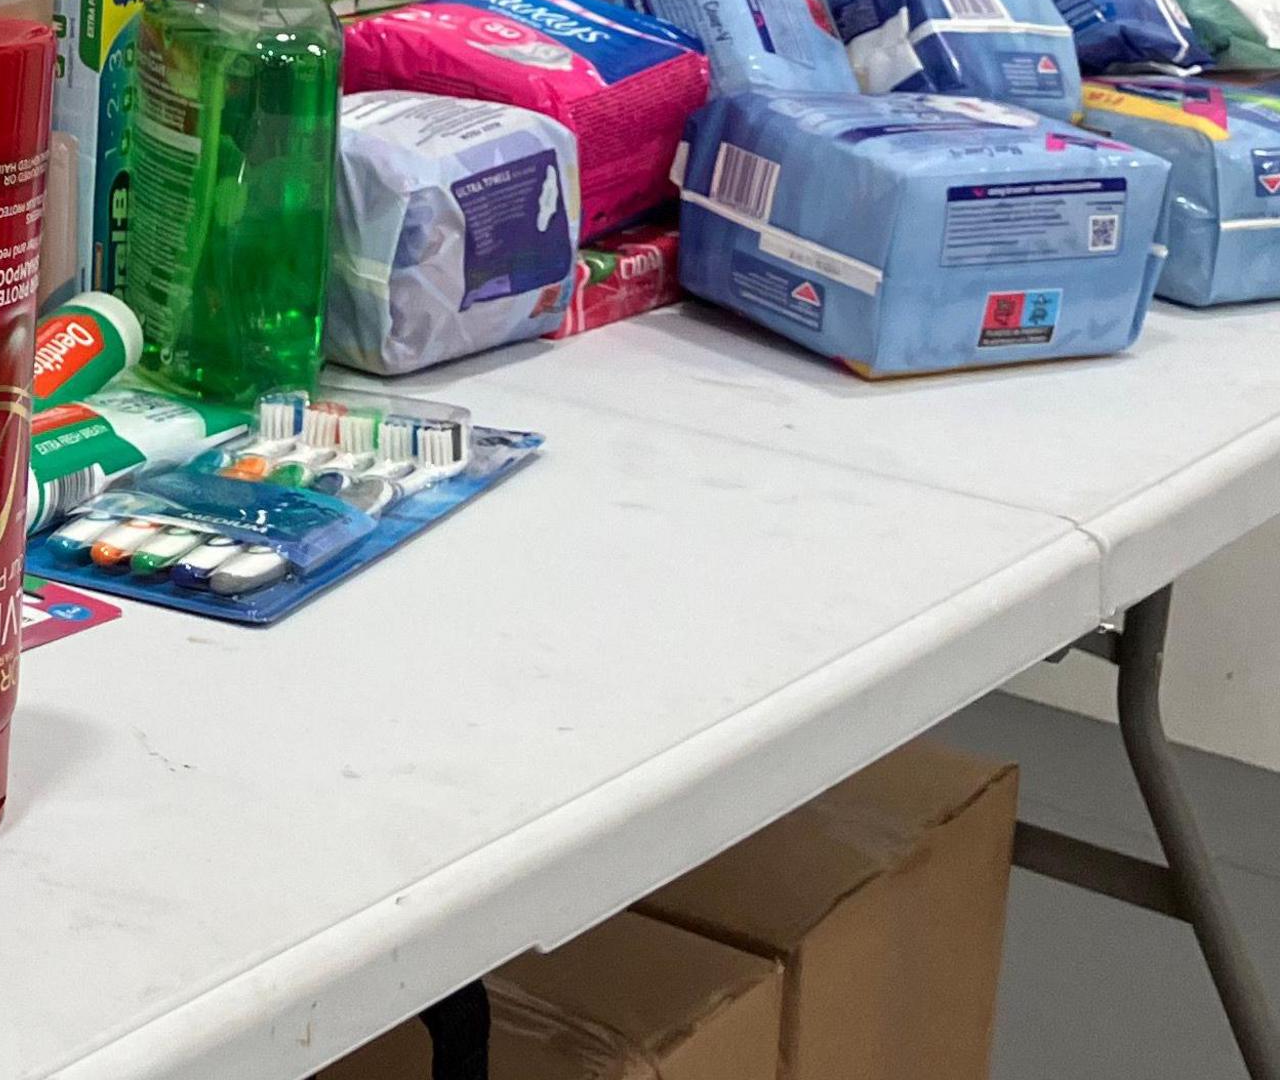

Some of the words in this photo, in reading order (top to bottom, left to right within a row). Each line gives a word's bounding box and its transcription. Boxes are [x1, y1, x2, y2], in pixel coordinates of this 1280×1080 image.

[86, 5, 95, 39] EXTRA
[12, 240, 27, 258] and
[35, 438, 62, 455] EXTRA
[60, 431, 81, 446] FRESH
